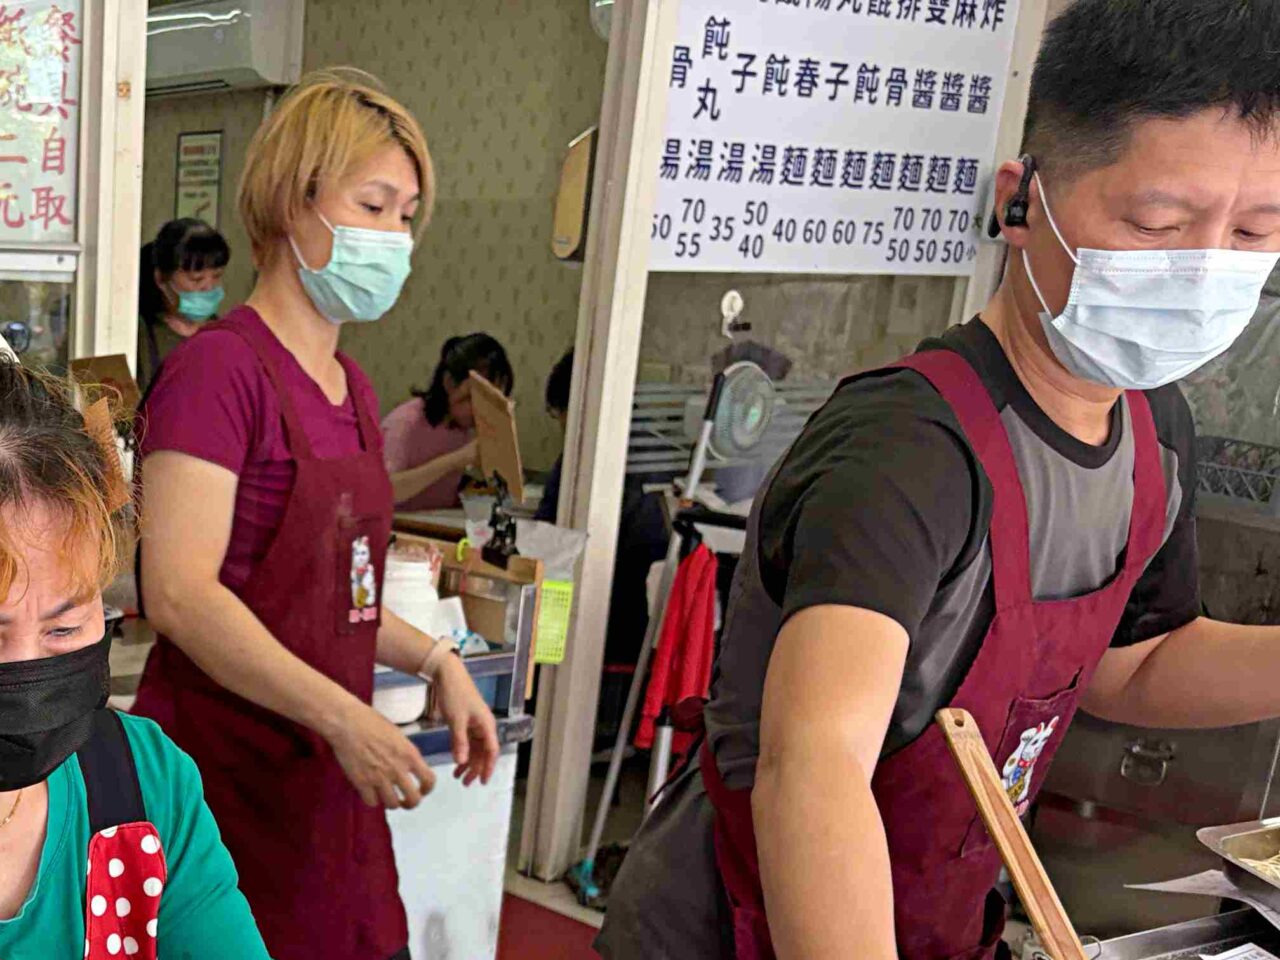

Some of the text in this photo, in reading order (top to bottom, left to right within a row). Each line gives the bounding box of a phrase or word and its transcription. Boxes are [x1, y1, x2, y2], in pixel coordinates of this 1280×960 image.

[682, 198, 706, 223] 70
[743, 200, 768, 226] 50
[894, 206, 970, 233] 70 70 70
[709, 216, 734, 241] 35
[772, 218, 797, 243] 40
[802, 219, 827, 244] 60
[832, 220, 856, 245] 60
[863, 221, 884, 246] 75
[675, 232, 701, 258] 55
[738, 234, 764, 259] 40
[886, 238, 965, 263] 50 50 50
